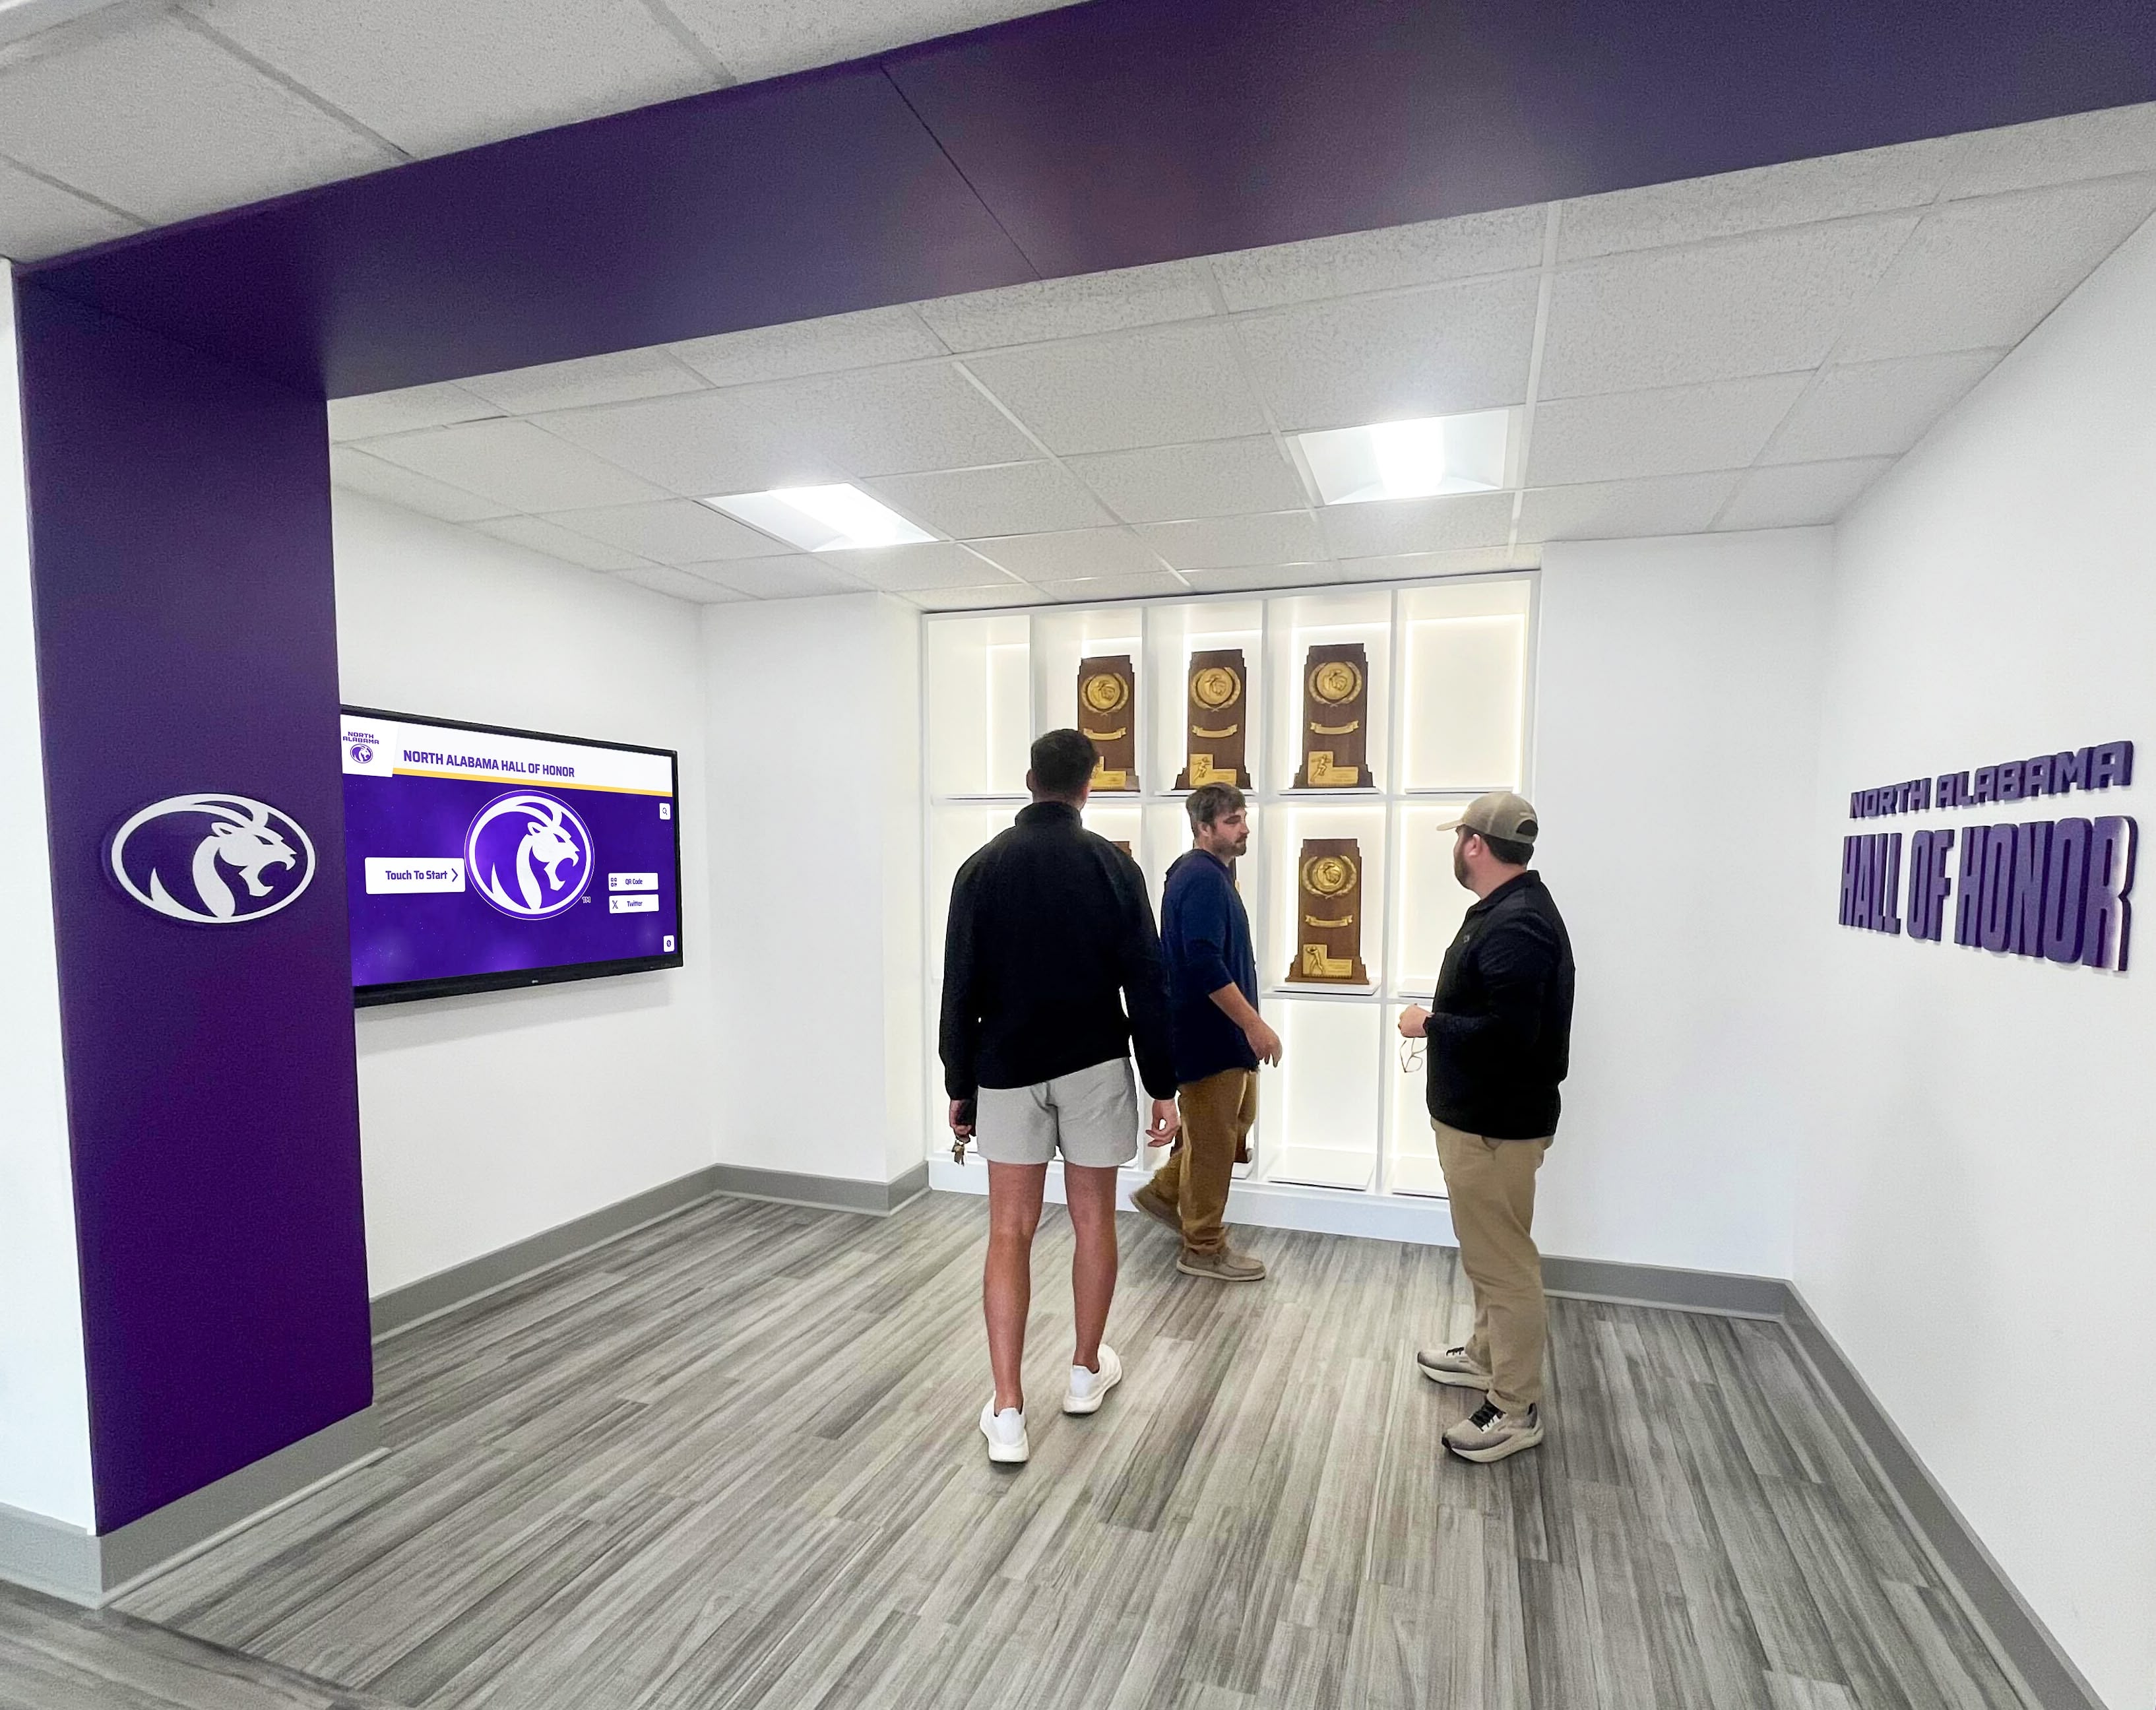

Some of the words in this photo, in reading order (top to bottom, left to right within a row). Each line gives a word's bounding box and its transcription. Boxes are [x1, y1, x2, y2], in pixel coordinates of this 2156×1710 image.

[342, 736, 379, 745] ALABAMA
[403, 749, 443, 765] NORTH
[446, 754, 499, 771] ALABAMA
[501, 759, 526, 773] HALL
[528, 763, 540, 774] OF
[542, 764, 575, 777] HONOR
[1849, 777, 1932, 819] NORTH
[1936, 740, 2134, 808] ALABAMA
[385, 870, 412, 880] Touch
[413, 870, 424, 880] To
[426, 870, 447, 879] Start
[1839, 833, 1902, 935] HALL
[1906, 829, 1955, 942] OF
[1954, 815, 2139, 972] HONOR
